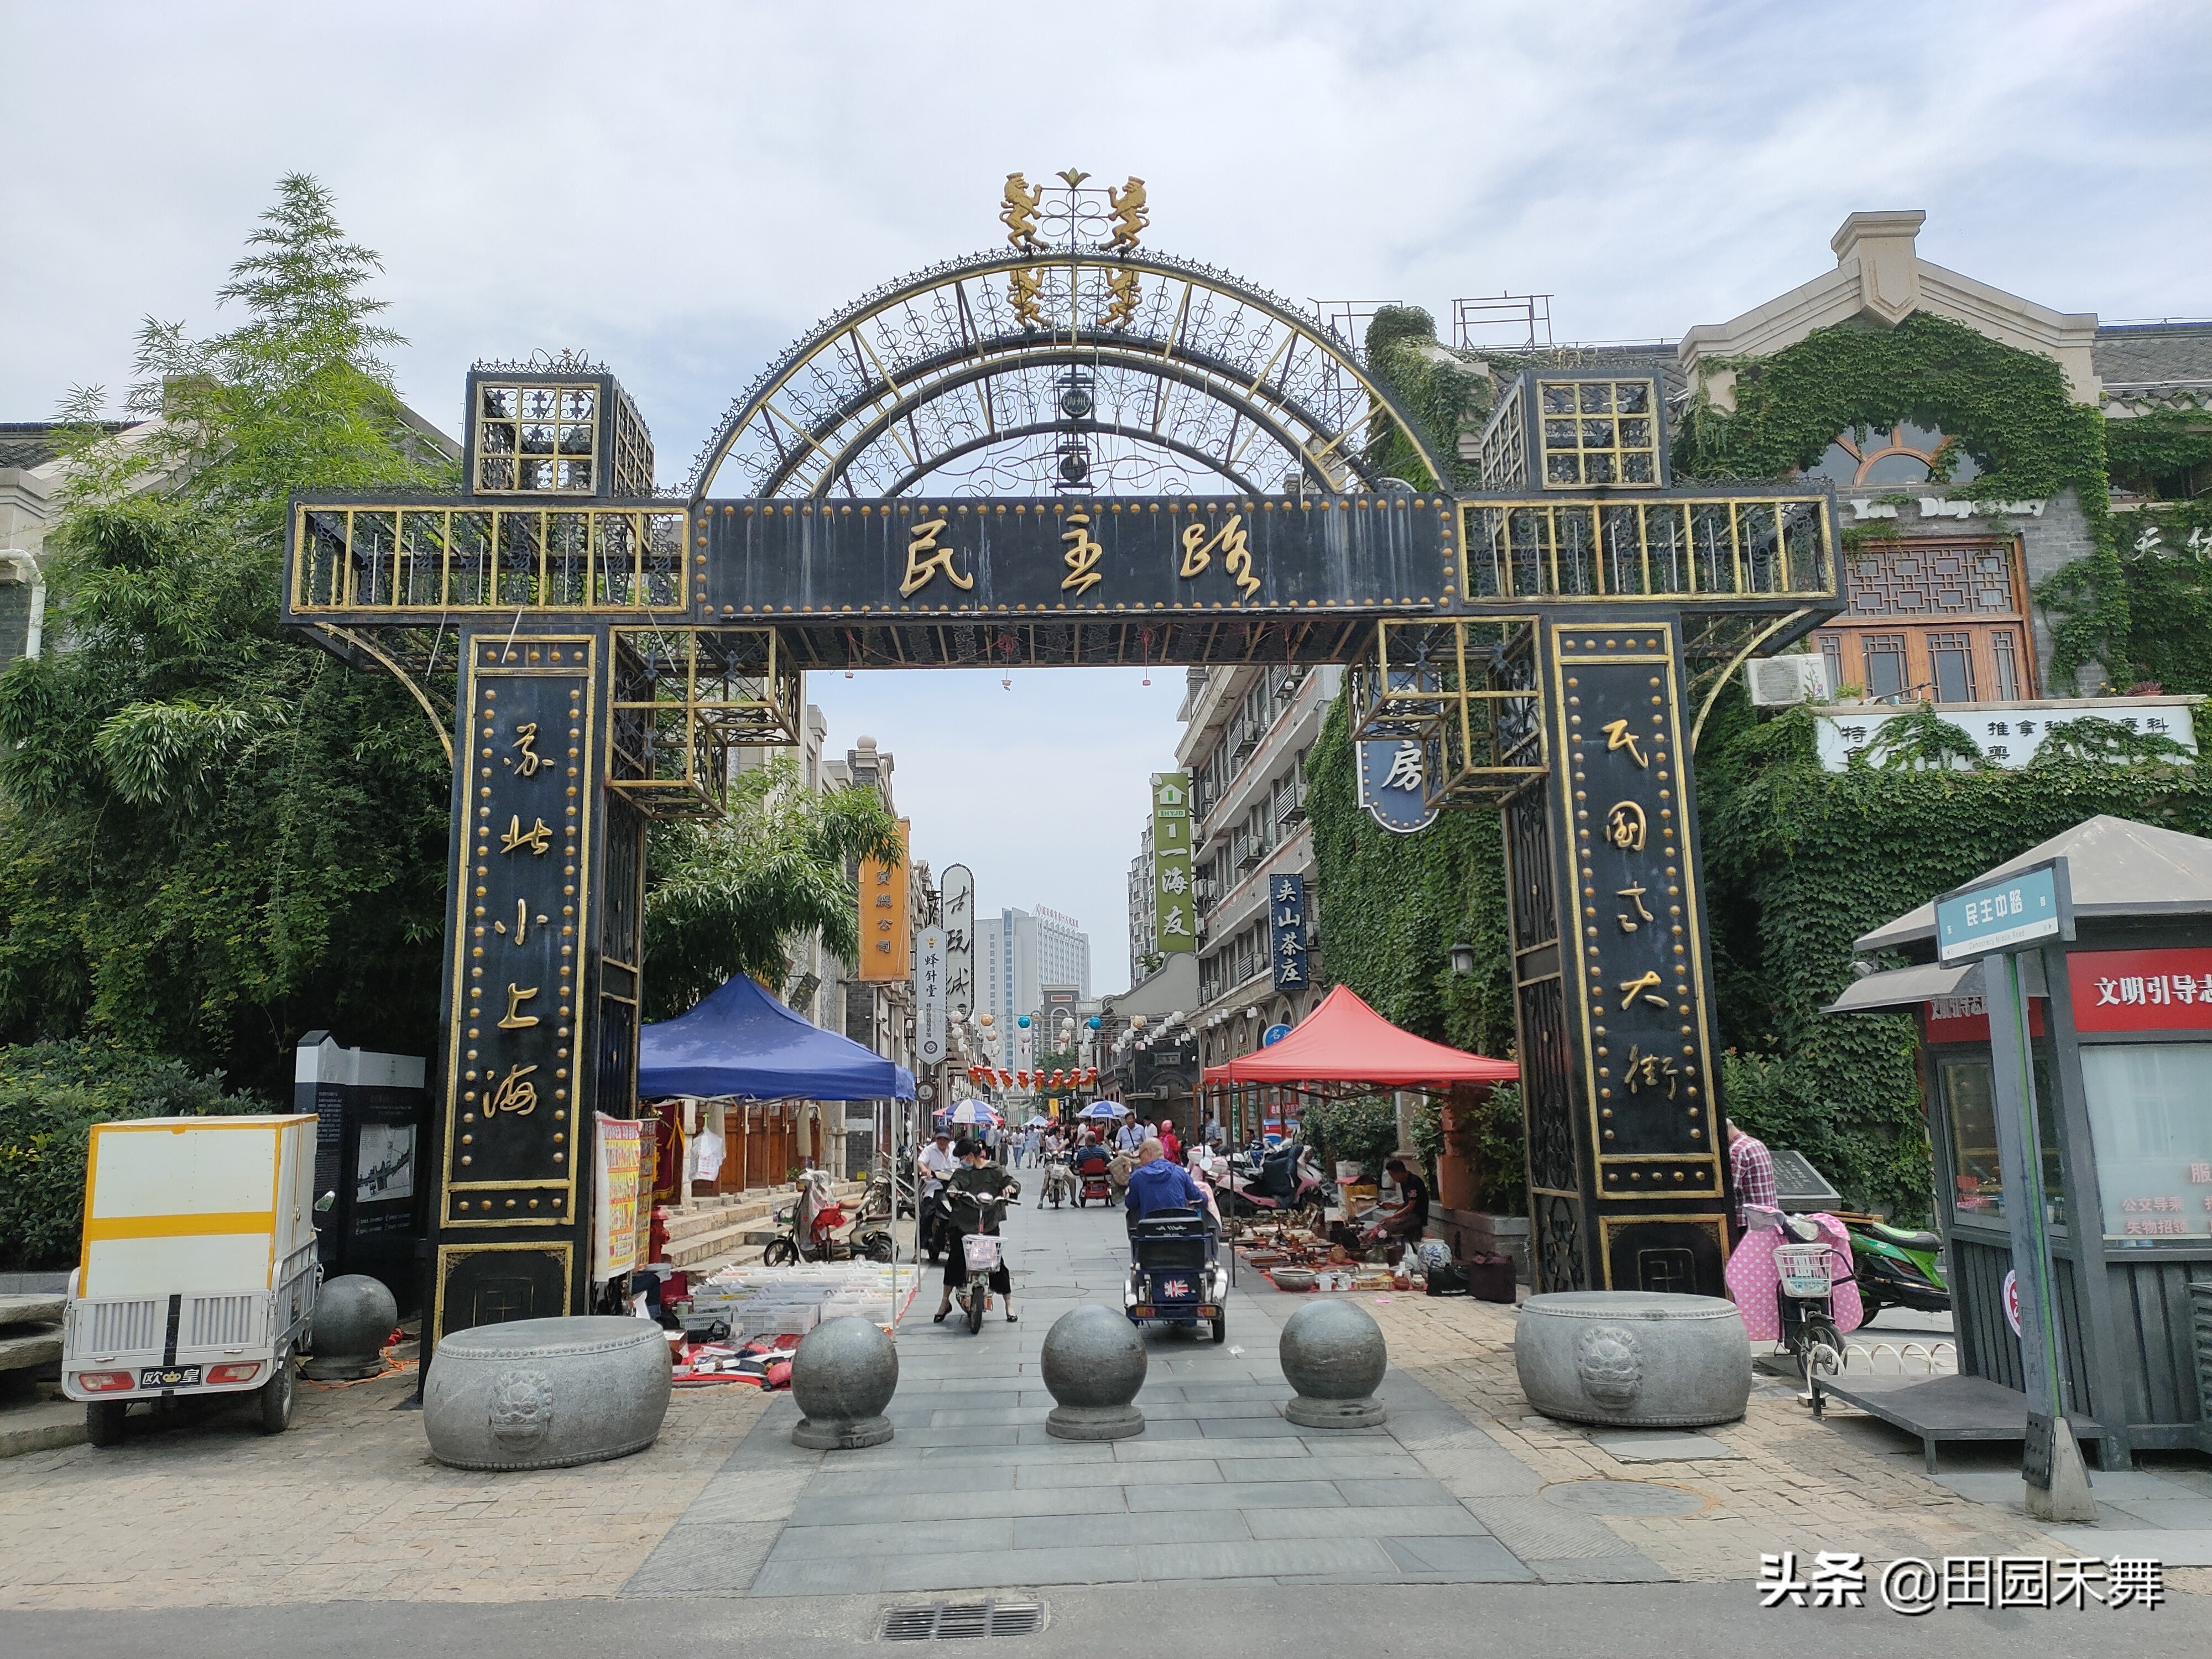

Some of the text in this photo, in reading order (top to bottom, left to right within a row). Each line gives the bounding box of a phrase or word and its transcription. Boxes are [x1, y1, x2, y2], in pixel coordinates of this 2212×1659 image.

[1919, 498, 2046, 519] Dispeary
[900, 514, 1260, 598] 民主路
[483, 723, 555, 1118] 苏北小上海
[1965, 889, 2023, 927] 民主中路
[1276, 879, 1305, 984] 夹山茶庄
[1996, 933, 2011, 943] Middle
[2012, 929, 2026, 938] Road
[2122, 1196, 2183, 1212] 公交导乘
[2127, 1218, 2188, 1235] 失物招领
